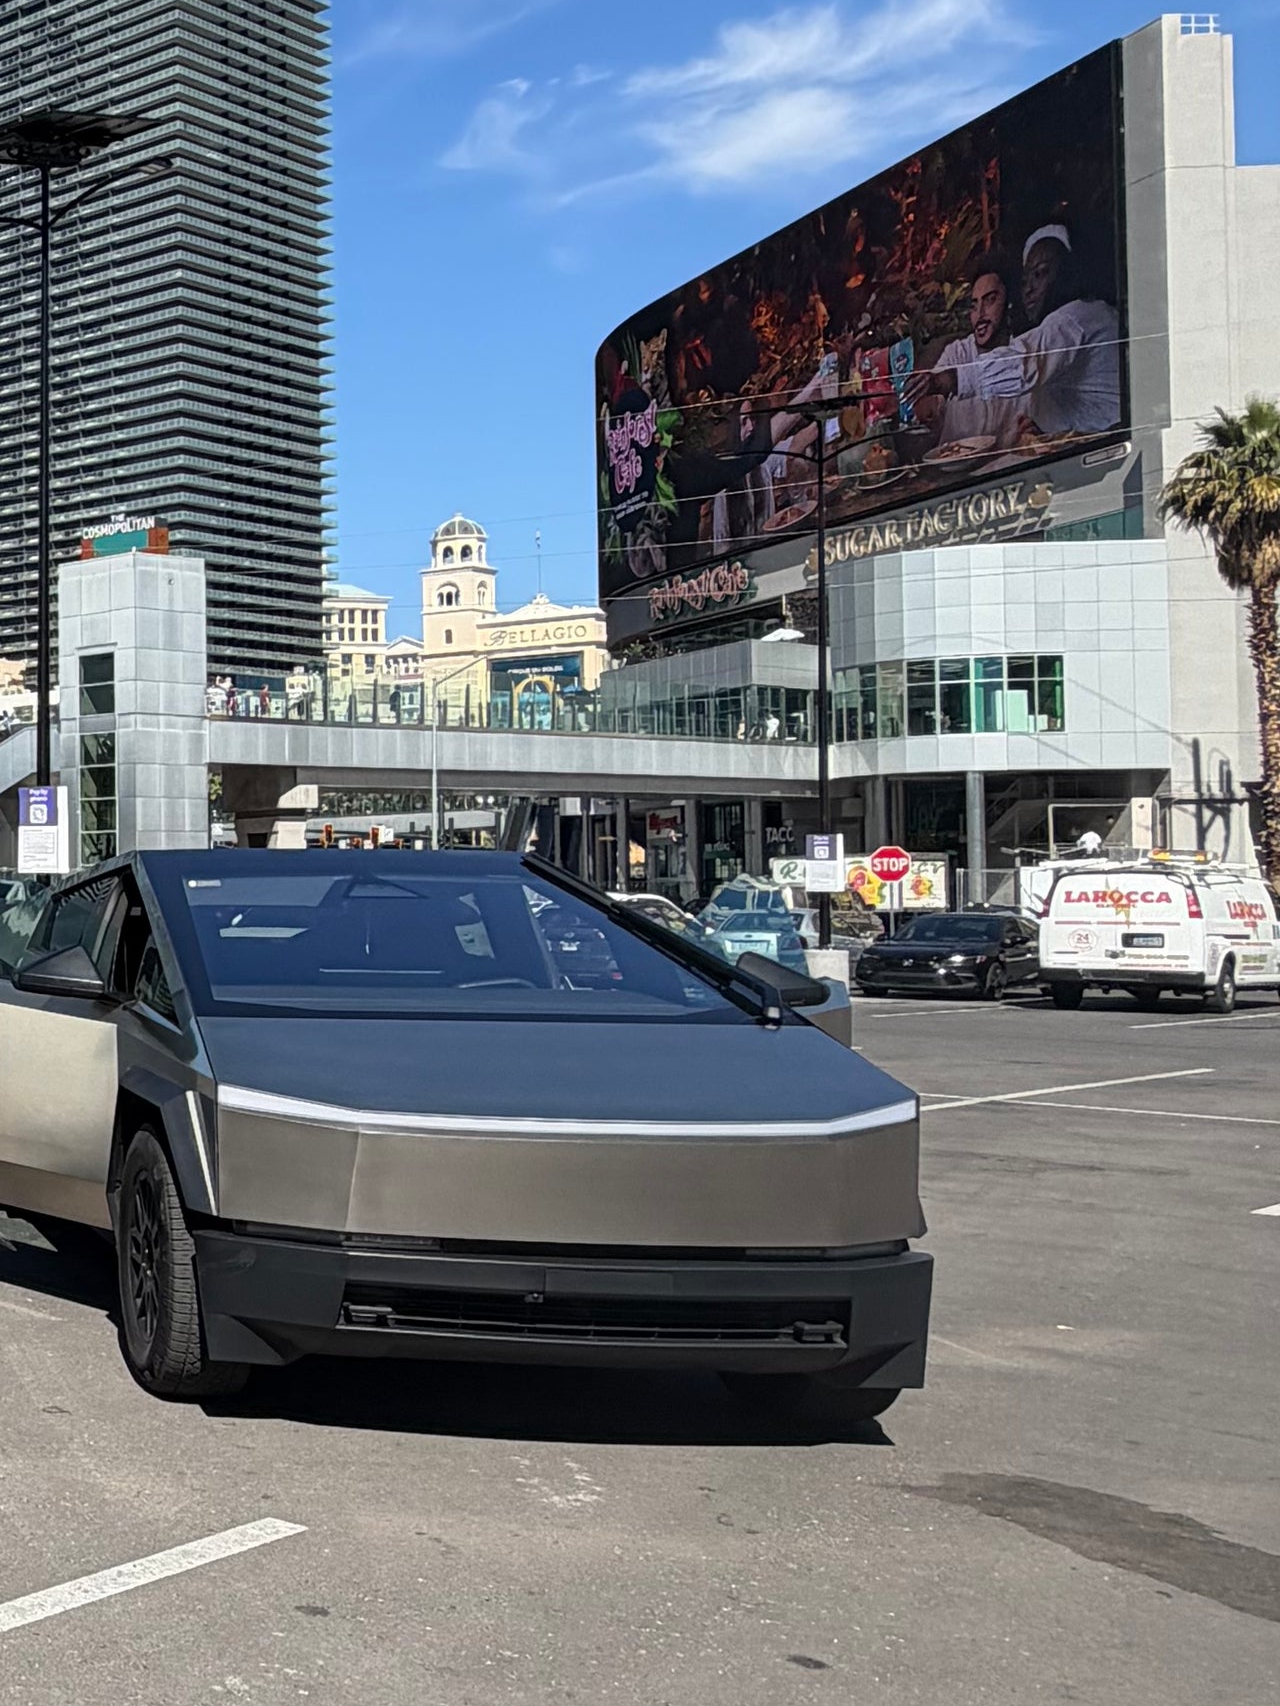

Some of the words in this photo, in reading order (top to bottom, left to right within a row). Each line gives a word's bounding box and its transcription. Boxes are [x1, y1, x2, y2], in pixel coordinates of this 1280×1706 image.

[82, 516, 155, 539] COSMOPOLITAN
[823, 520, 903, 566] SUGAR
[905, 482, 1024, 540] FACTORY
[483, 625, 587, 646] BELLAGIO
[872, 857, 908, 872] STOP
[1064, 890, 1172, 903] LAROCCA
